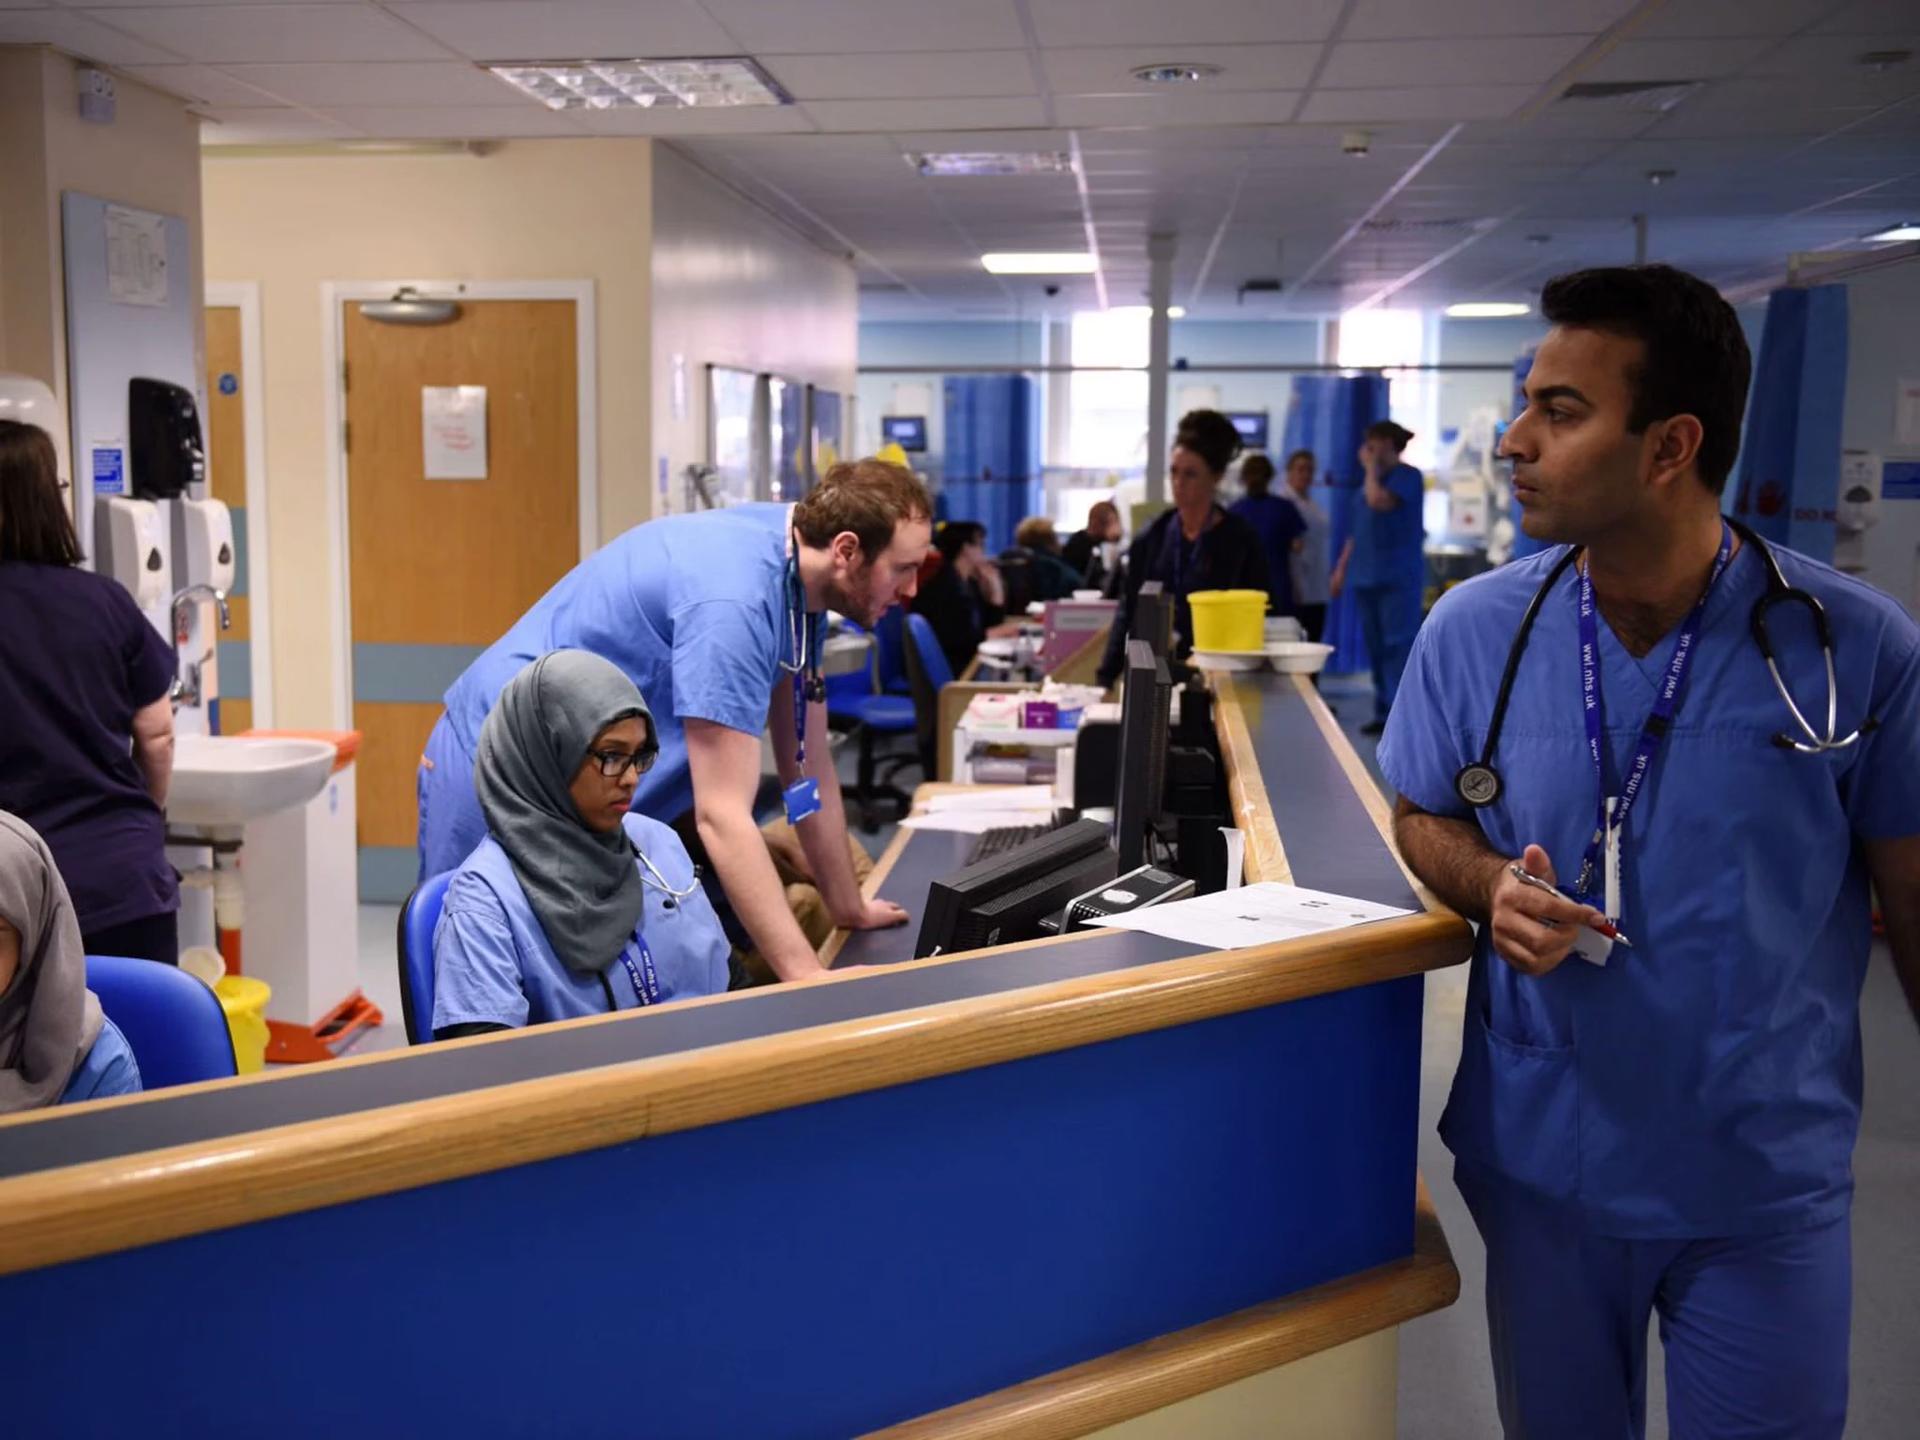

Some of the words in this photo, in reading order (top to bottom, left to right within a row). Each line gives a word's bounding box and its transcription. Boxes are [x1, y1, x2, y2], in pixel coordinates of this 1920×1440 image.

[1583, 643, 1596, 710] wwl.nhs.uk
[1664, 632, 1692, 699] wwl.nhs.uk
[1617, 753, 1649, 821] wwl.nhs.uk
